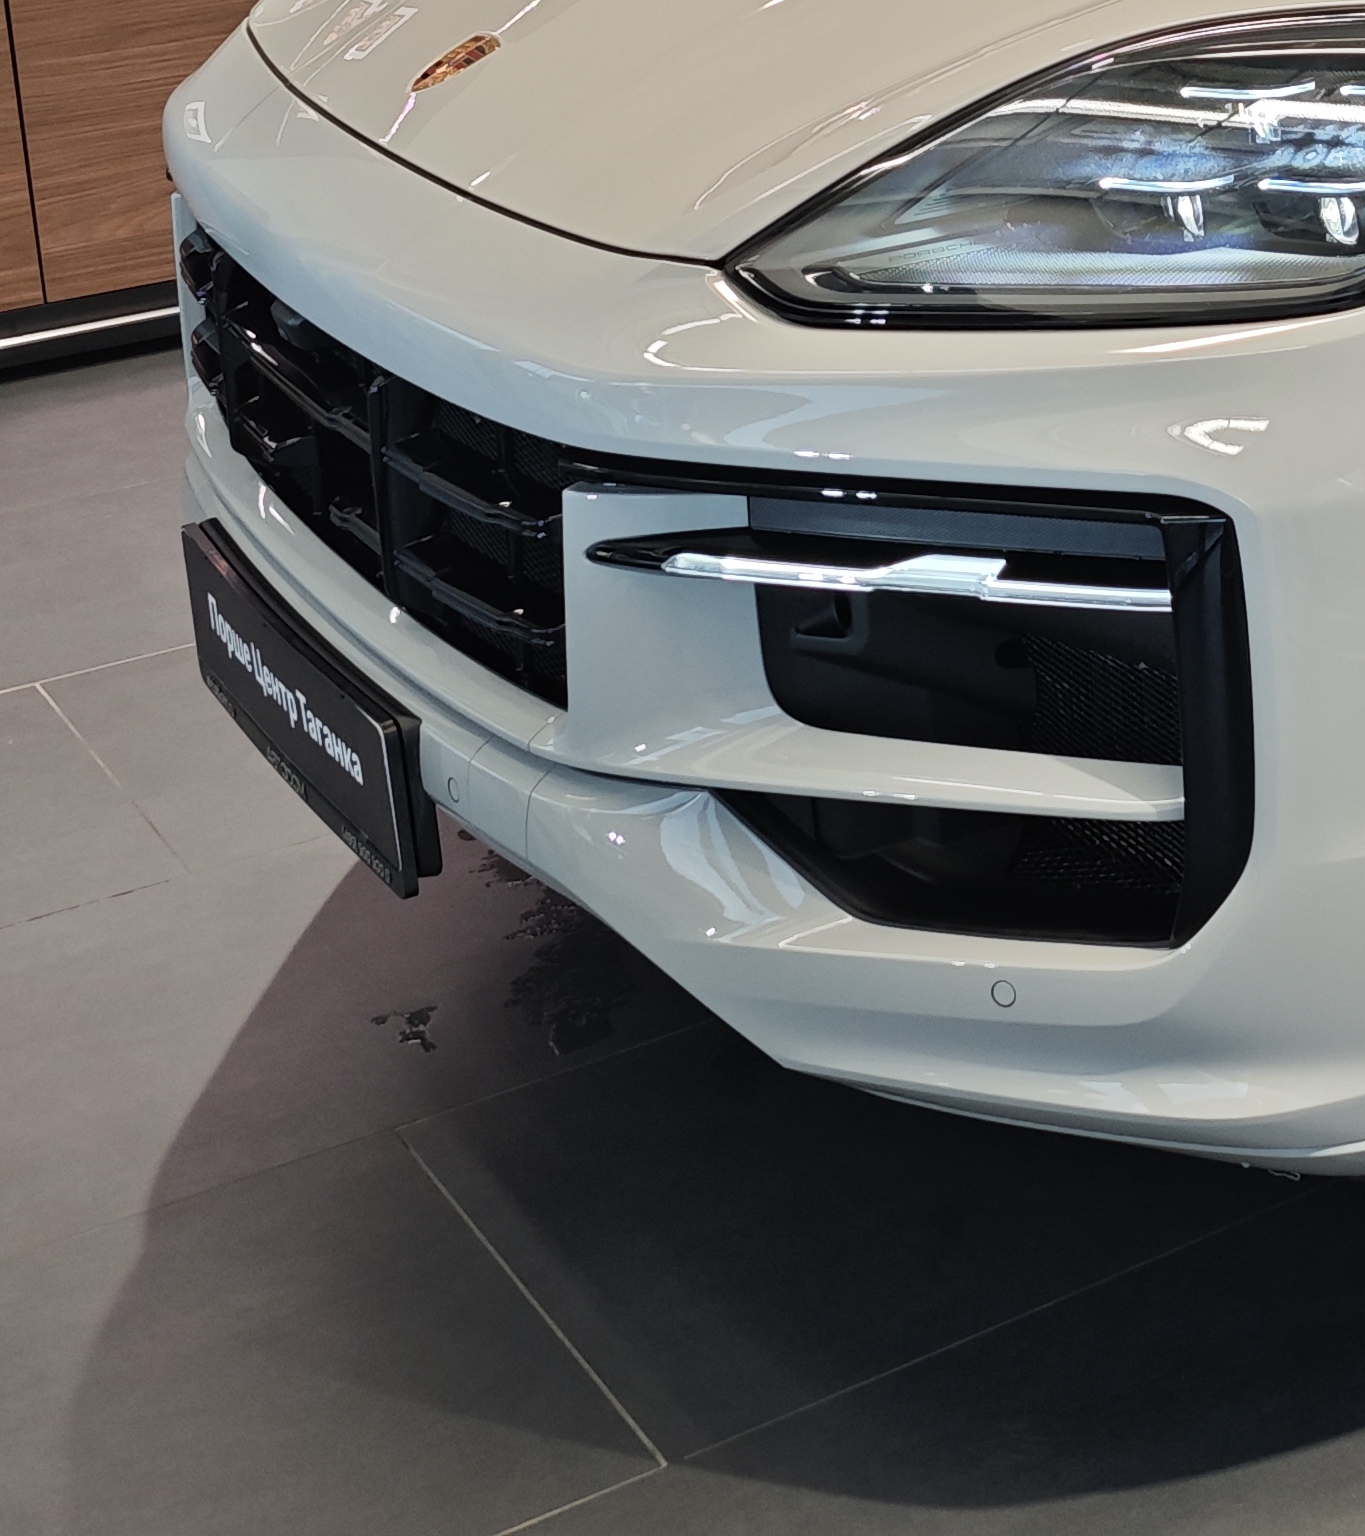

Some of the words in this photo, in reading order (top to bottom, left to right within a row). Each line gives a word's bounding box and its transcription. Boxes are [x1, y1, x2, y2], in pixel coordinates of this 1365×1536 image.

[207, 592, 253, 673] Порше
[249, 640, 299, 729] Центр
[295, 688, 364, 786] Таганка
